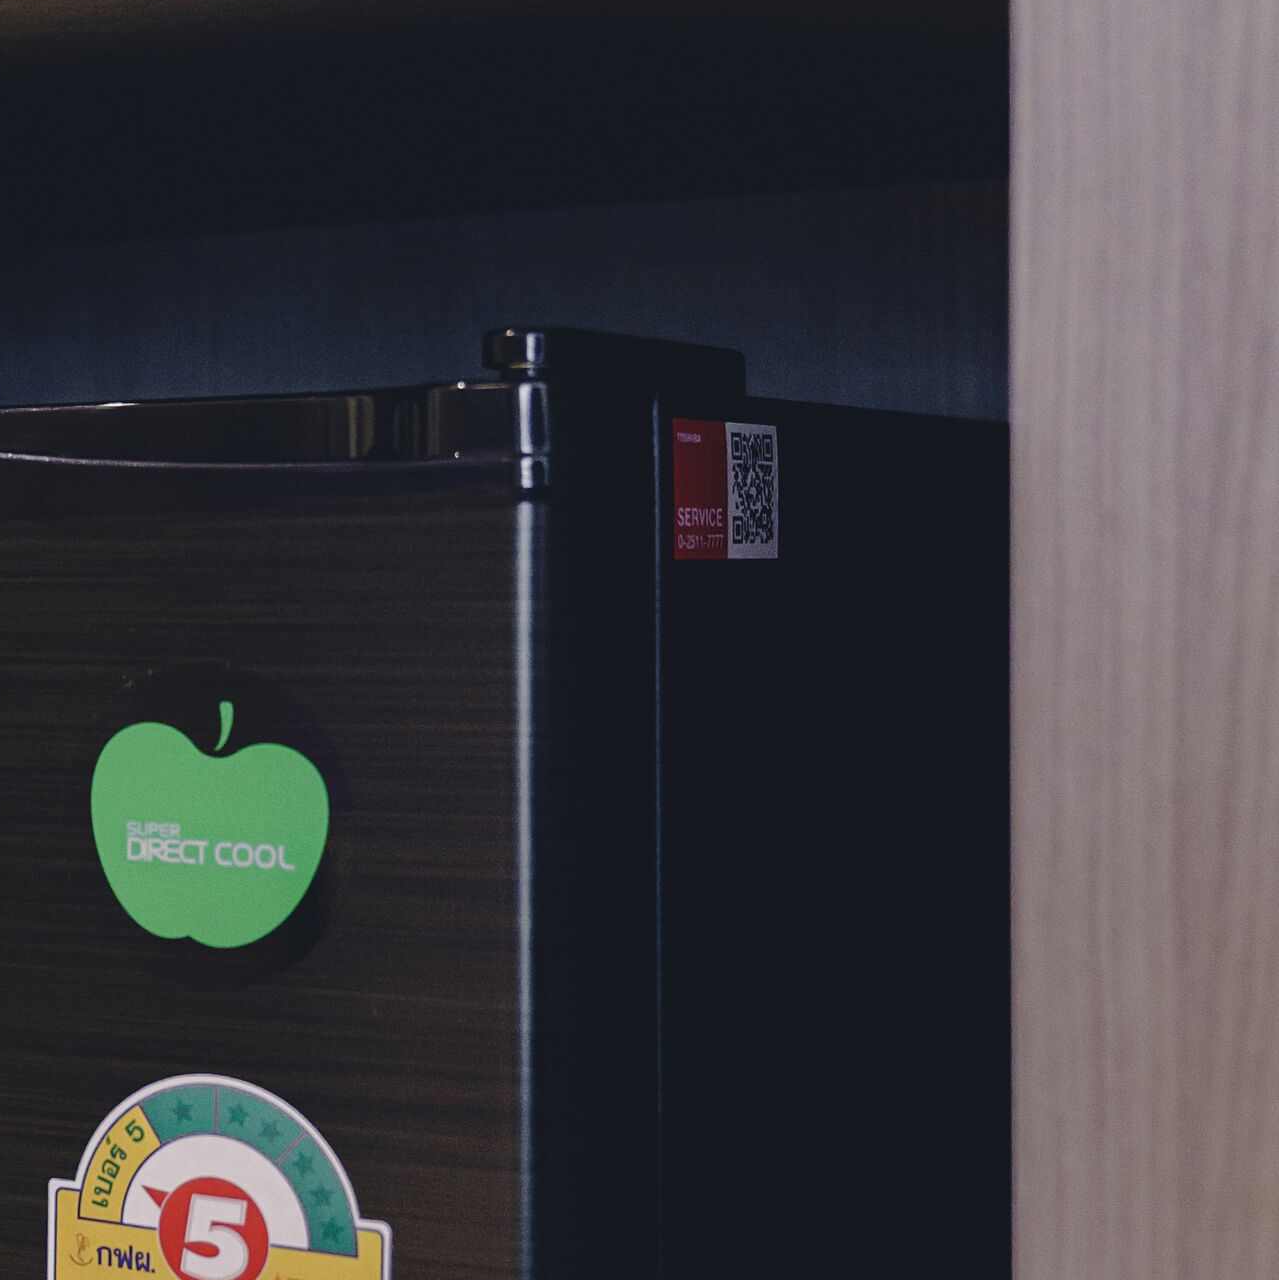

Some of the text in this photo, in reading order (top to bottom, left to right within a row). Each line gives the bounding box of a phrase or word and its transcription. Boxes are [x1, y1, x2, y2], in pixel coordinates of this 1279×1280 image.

[677, 507, 723, 527] SERVICE
[677, 534, 724, 550] 0-2511-7777
[126, 821, 180, 837] SUPER
[126, 837, 295, 870] DIRECT COOL
[91, 1119, 145, 1208] เบอร์ 5
[96, 1245, 156, 1273] กฟผ.
